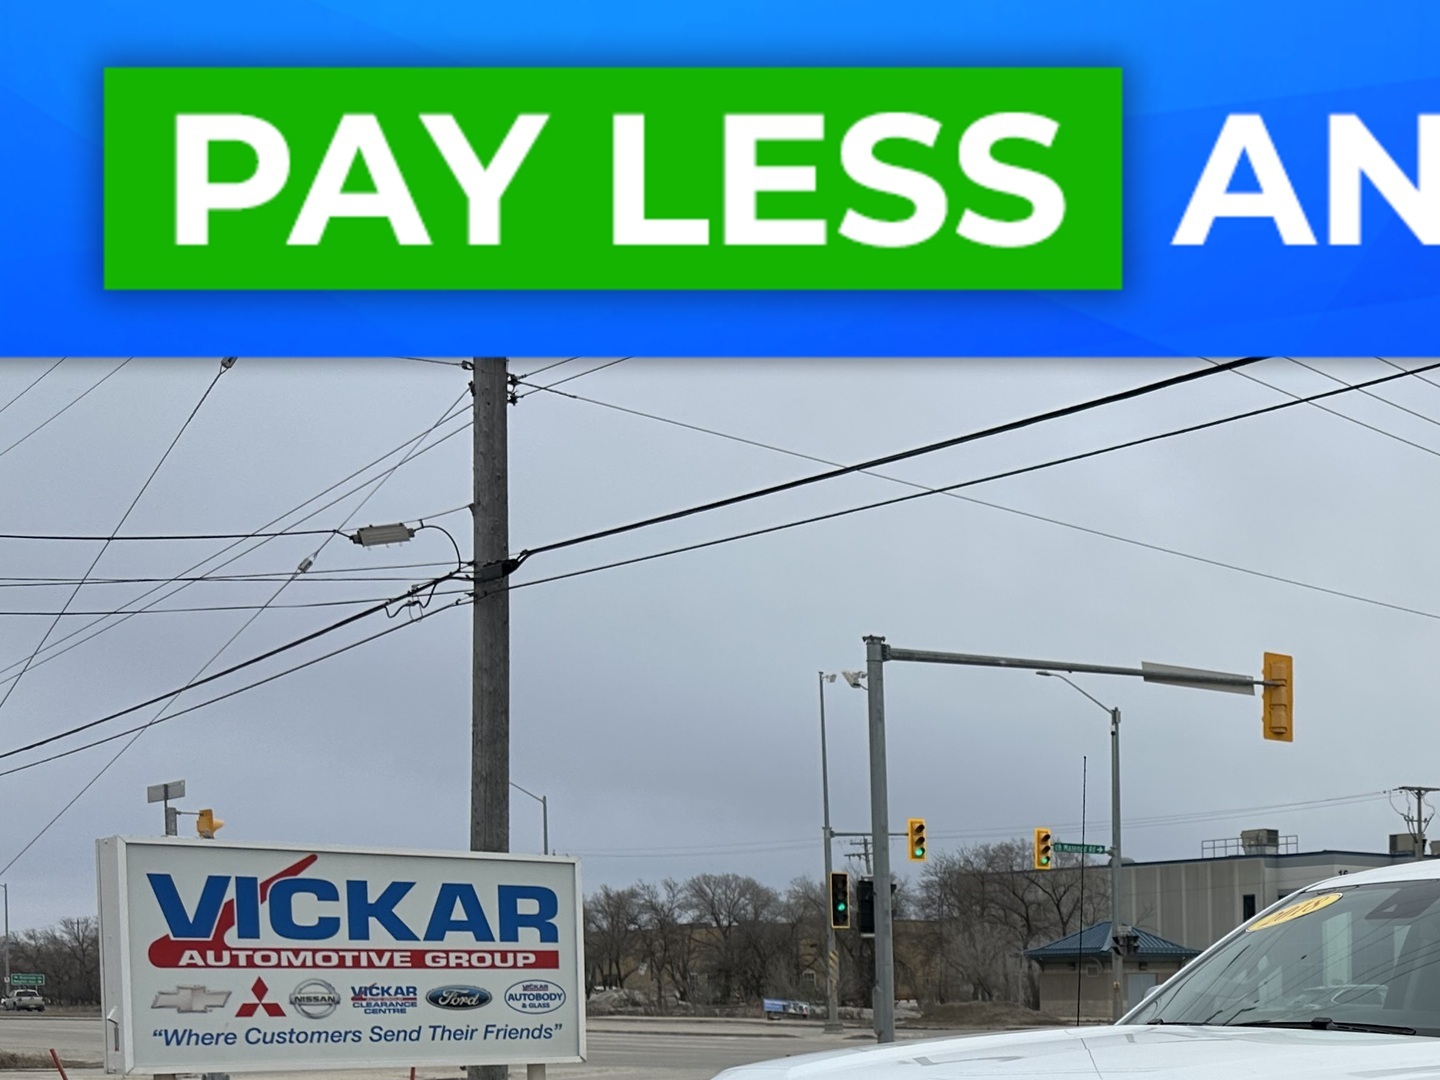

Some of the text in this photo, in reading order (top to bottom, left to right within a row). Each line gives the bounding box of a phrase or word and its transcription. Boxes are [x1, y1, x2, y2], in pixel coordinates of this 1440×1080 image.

[147, 872, 559, 943] VICKAR
[178, 949, 536, 968] AUTOMOTIVE GROUP
[351, 985, 418, 997] VICKAR
[438, 989, 480, 1006] Ford
[508, 993, 563, 1001] AUTOBODY
[244, 1027, 362, 1045] Customers
[369, 1025, 422, 1043] Send
[428, 1024, 481, 1041] Their
